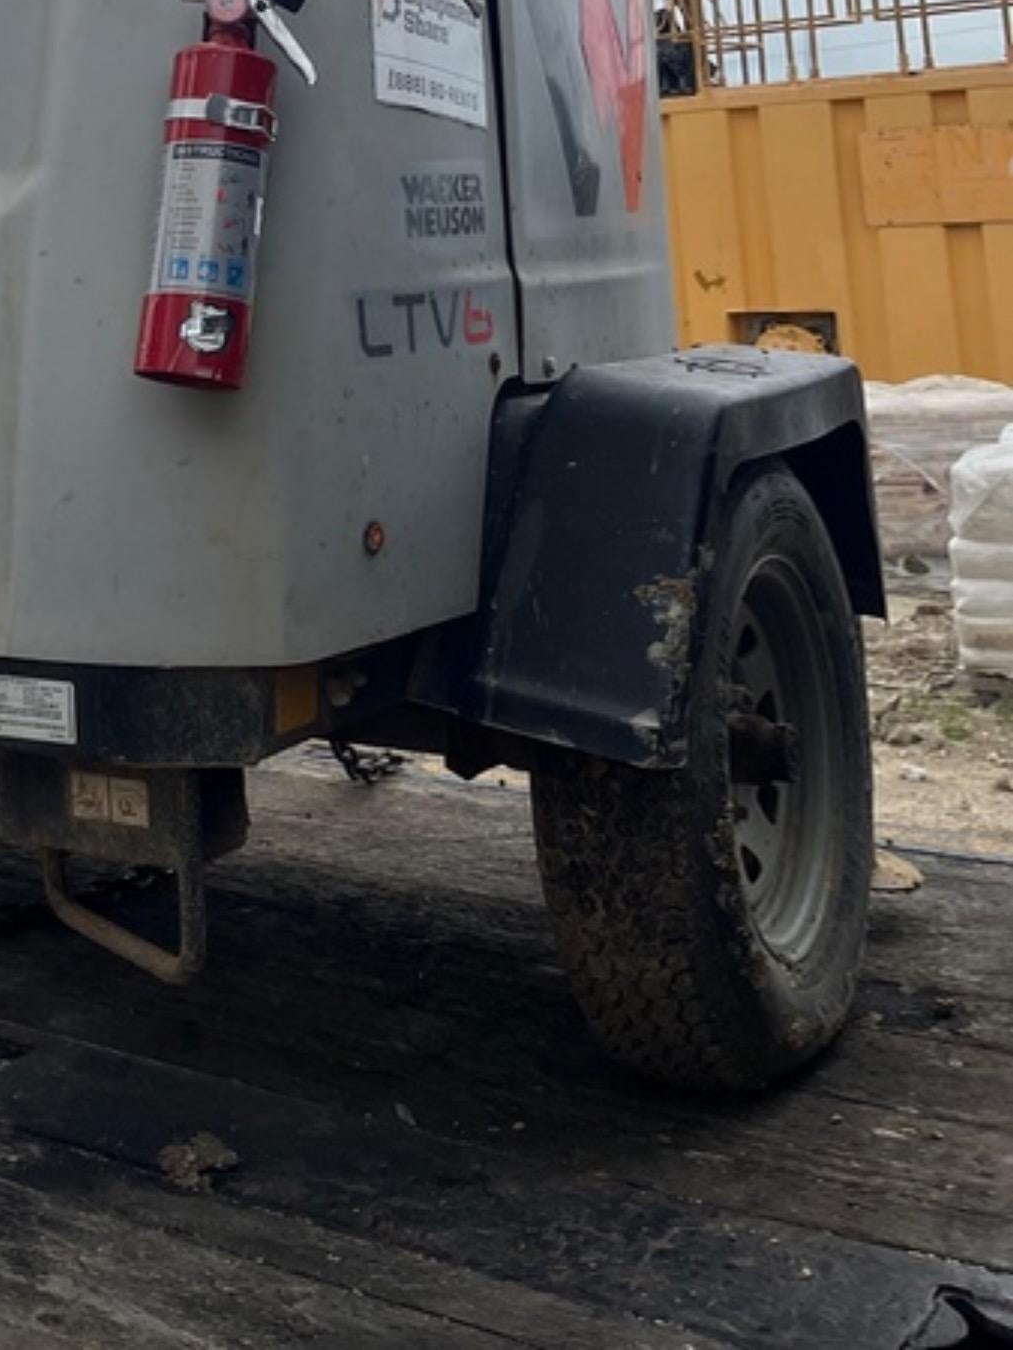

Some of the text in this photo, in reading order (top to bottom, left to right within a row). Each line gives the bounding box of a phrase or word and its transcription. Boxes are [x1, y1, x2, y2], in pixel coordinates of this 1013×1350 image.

[403, 9, 450, 46] Share
[400, 173, 484, 204] WACKER
[404, 206, 487, 238] NEUSON
[356, 288, 495, 358] LTV6
